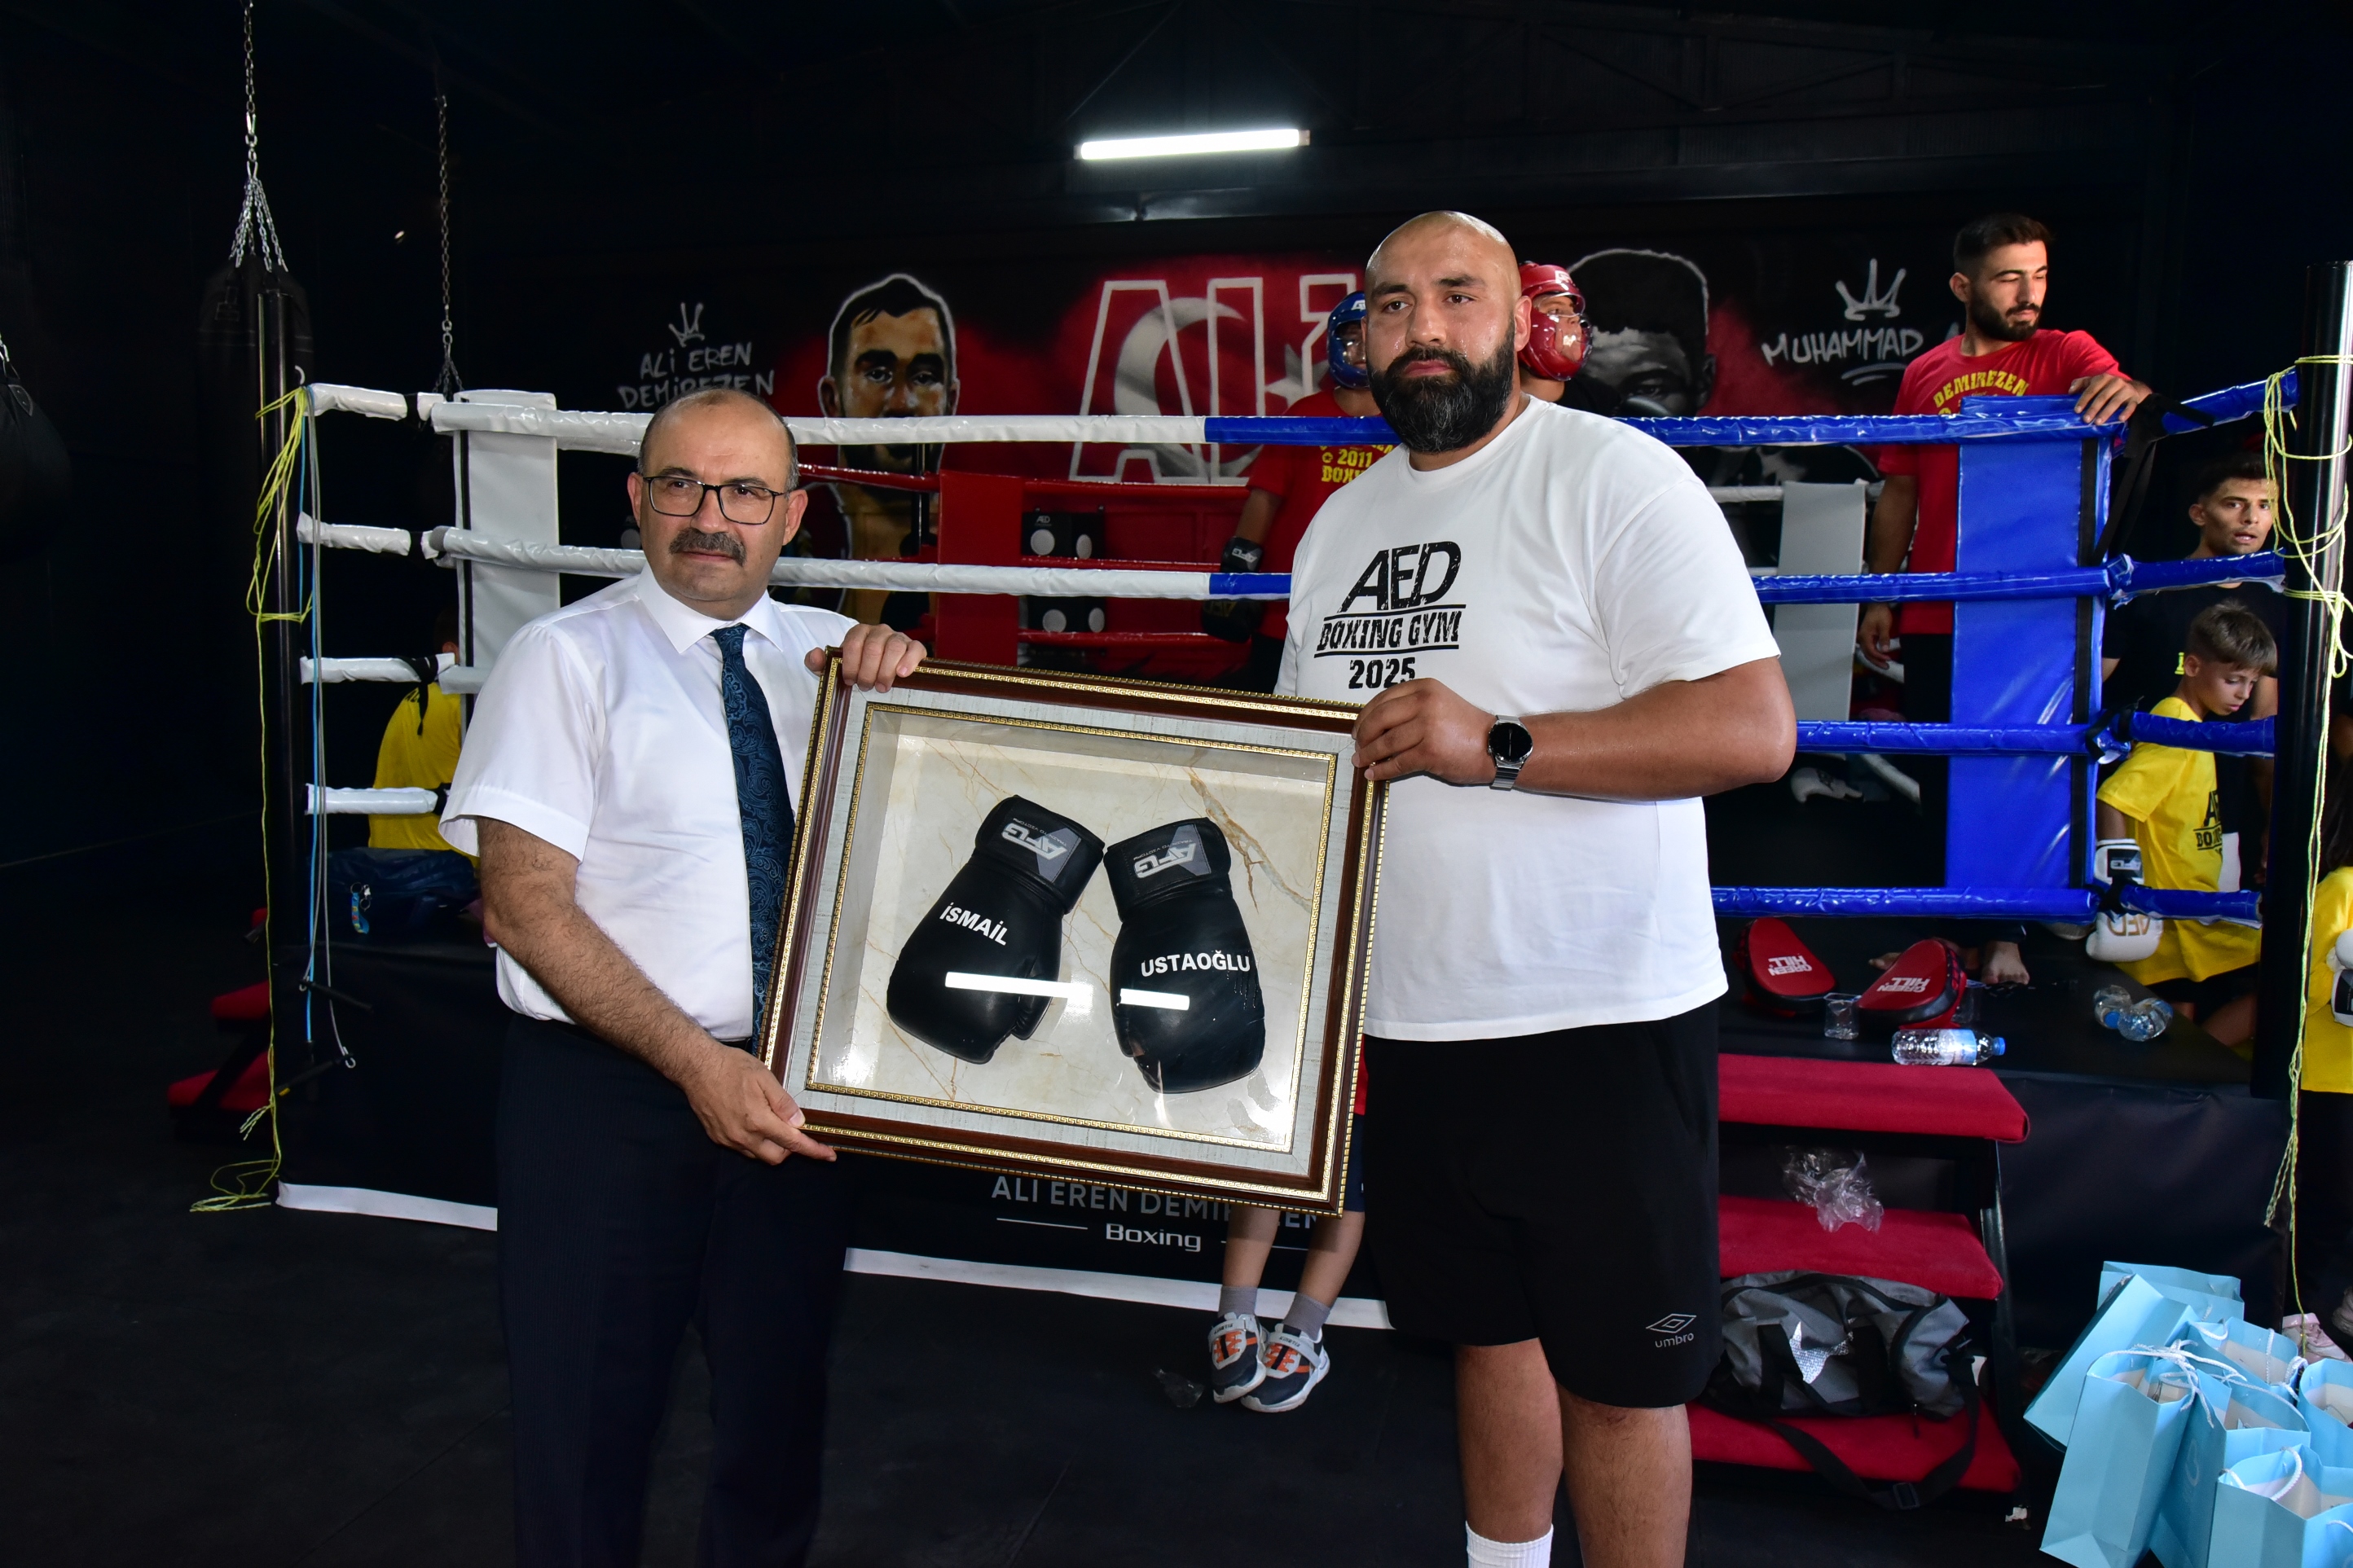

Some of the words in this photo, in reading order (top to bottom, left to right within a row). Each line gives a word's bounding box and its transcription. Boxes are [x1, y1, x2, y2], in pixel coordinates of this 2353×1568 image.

[687, 340, 753, 373] EREN
[1761, 327, 1924, 366] MUHAMMAD
[1337, 448, 1374, 468] 2011
[1336, 540, 1462, 613] AED
[1316, 617, 1404, 652] BOXING
[1408, 609, 1462, 646] GYM
[1348, 657, 1416, 690] 2025
[1141, 949, 1251, 977] USTAOĞLU
[1767, 955, 1808, 968] HILL
[1767, 964, 1814, 977] GREEN
[1876, 982, 1927, 994] GREEN
[1891, 976, 1931, 986] HILL
[991, 1175, 1039, 1204] ALI
[1050, 1180, 1128, 1212] EREN
[1105, 1223, 1203, 1254] Boxing
[1655, 1332, 1695, 1349] umbro
